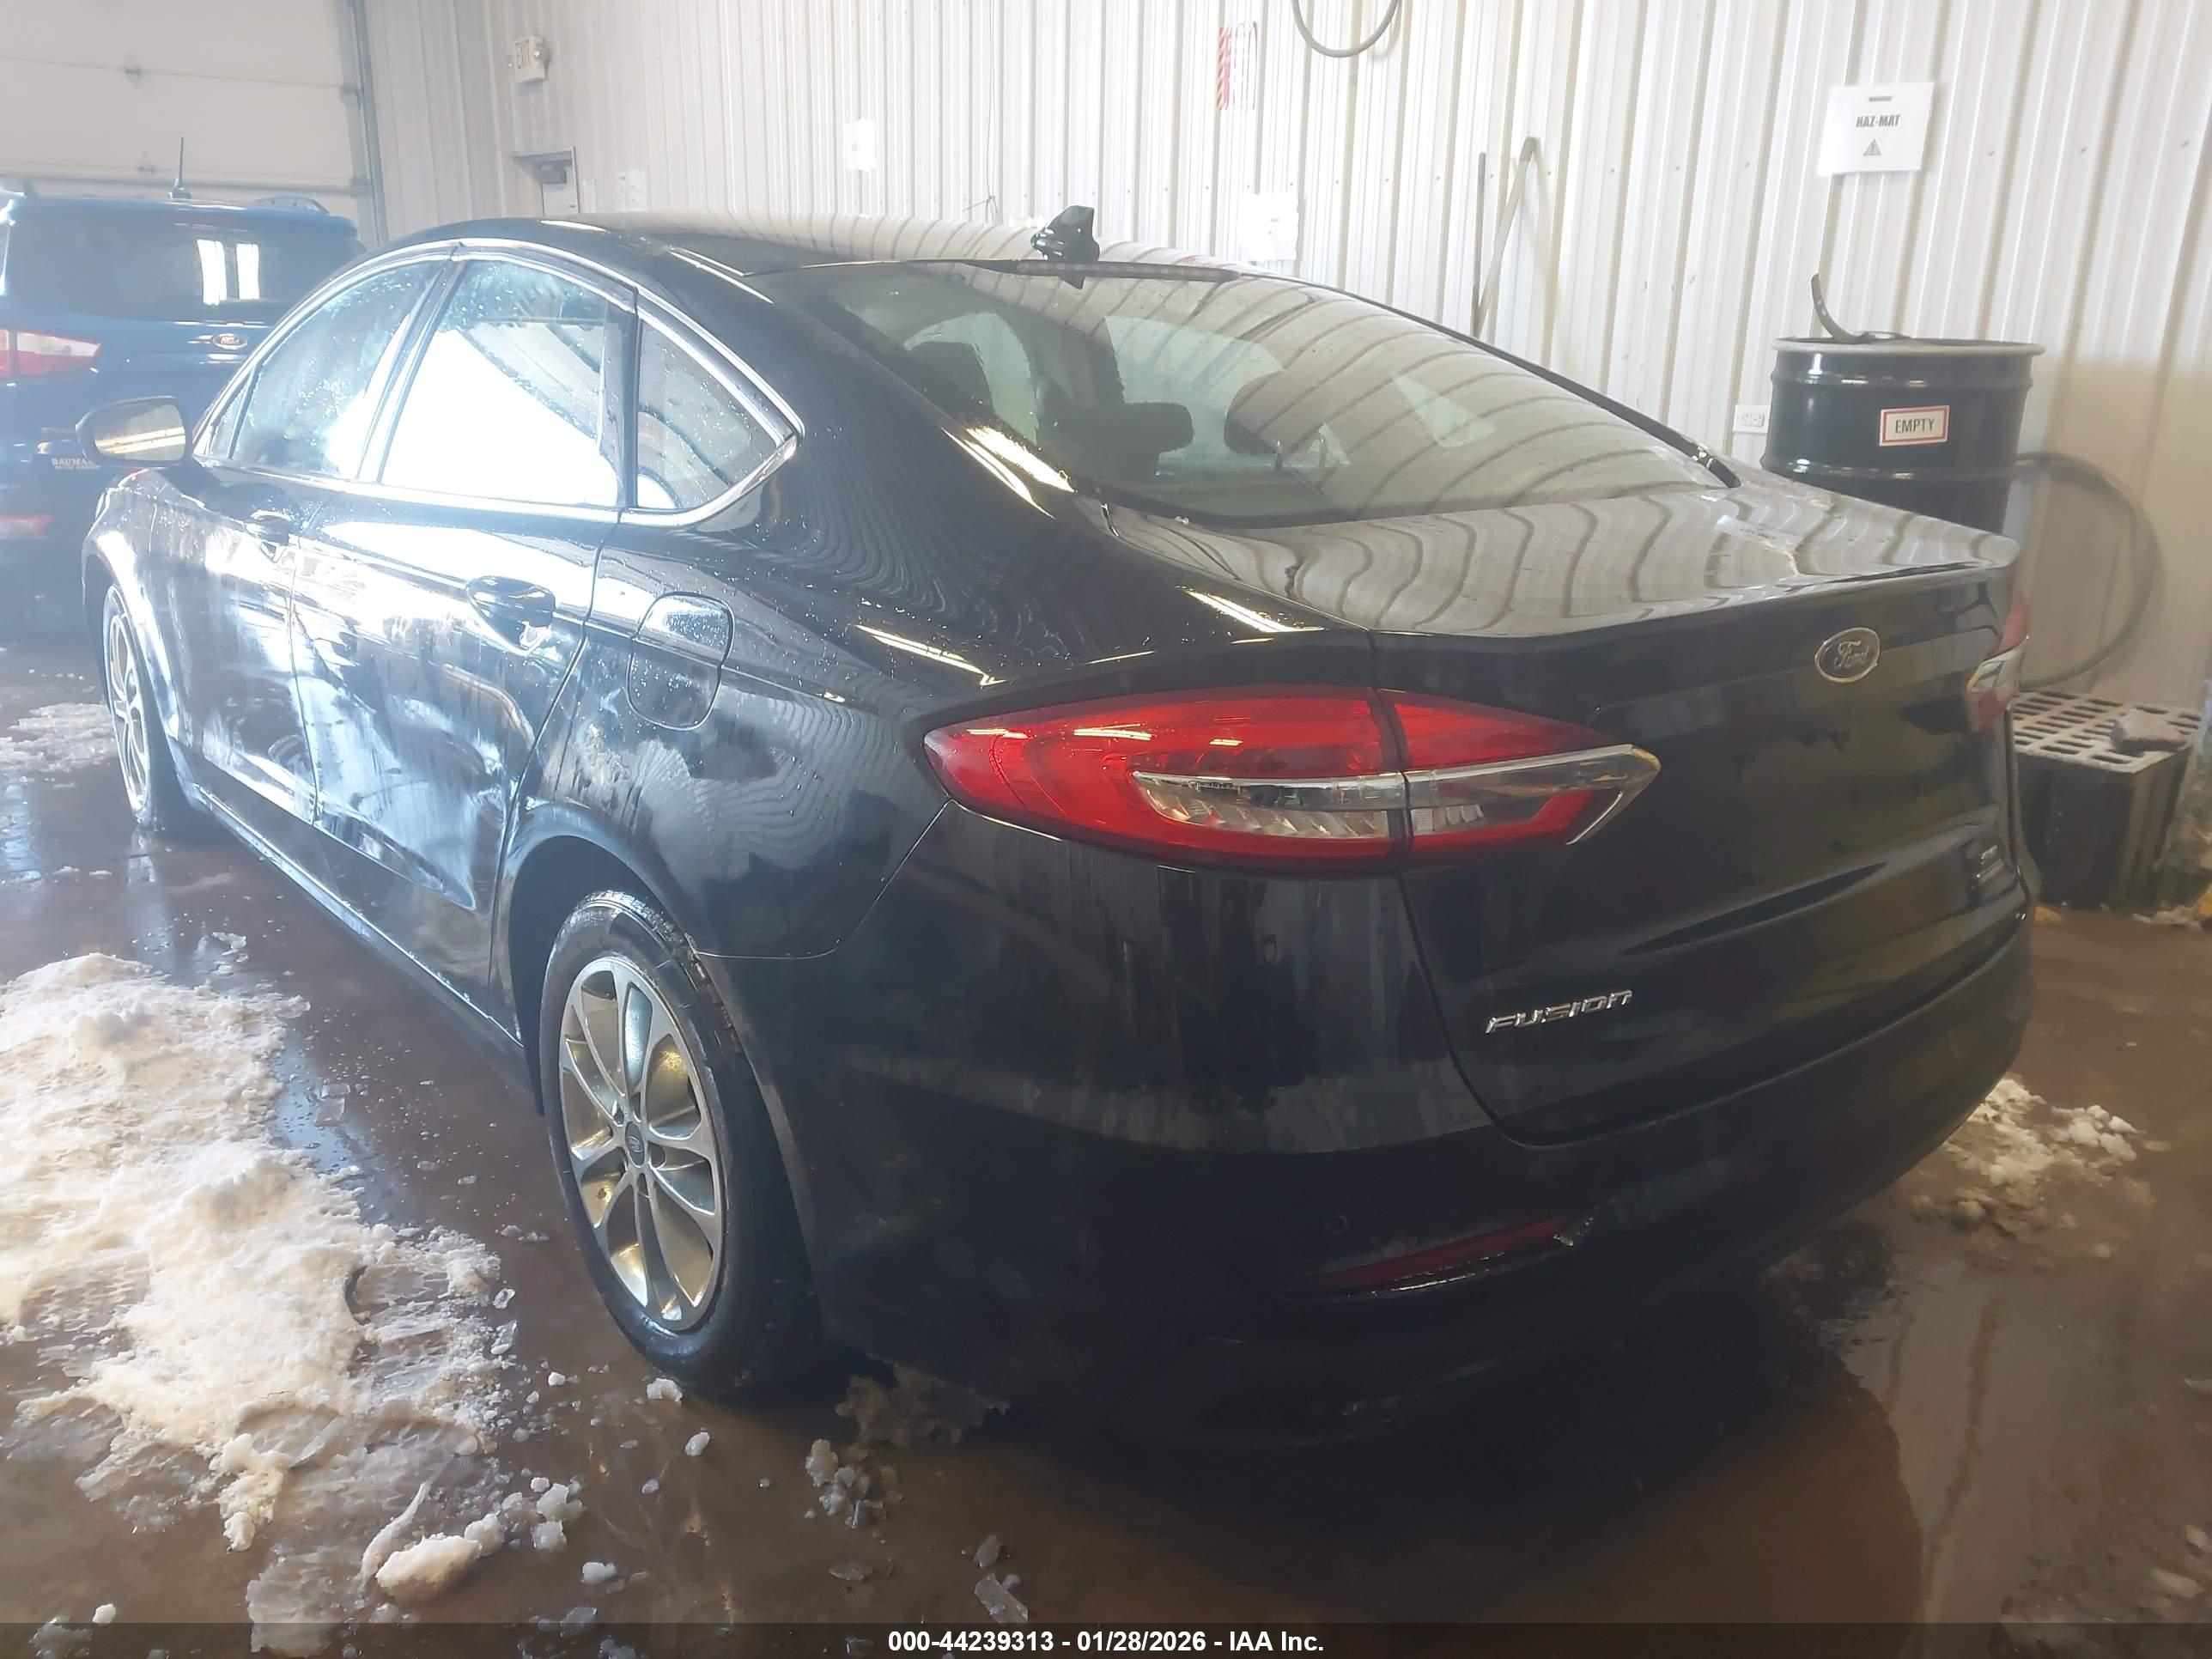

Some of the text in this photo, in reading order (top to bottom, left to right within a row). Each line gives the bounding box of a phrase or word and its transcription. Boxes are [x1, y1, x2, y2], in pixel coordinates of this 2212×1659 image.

[1856, 114, 1901, 128] HAZ-MAT
[1895, 417, 1936, 434] EMPTY
[1833, 640, 1870, 668] Ford
[1486, 989, 1632, 1034] FUSION
